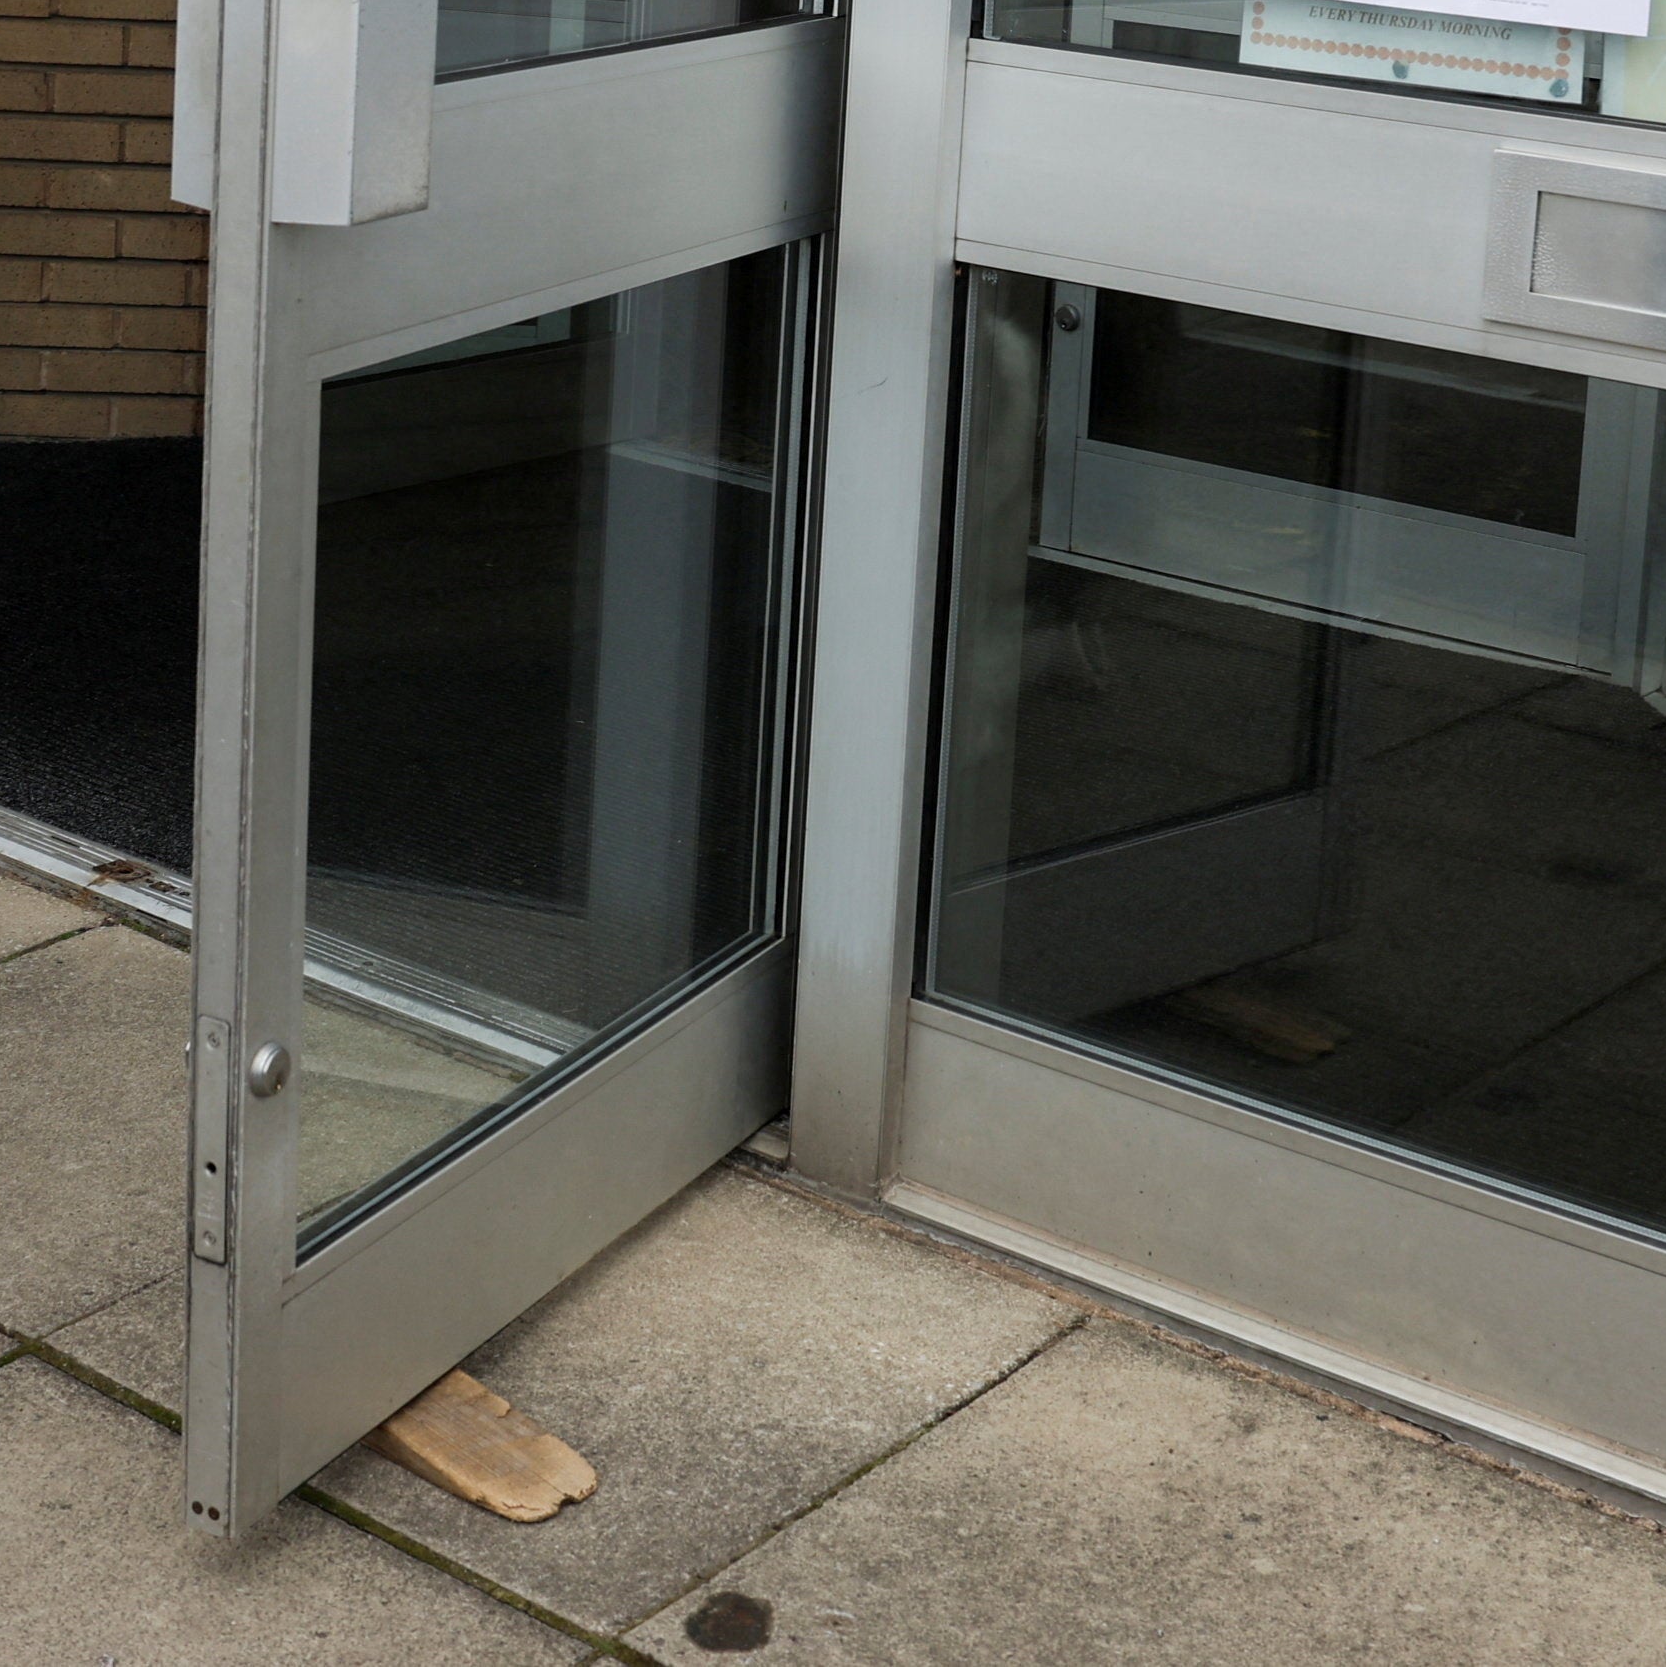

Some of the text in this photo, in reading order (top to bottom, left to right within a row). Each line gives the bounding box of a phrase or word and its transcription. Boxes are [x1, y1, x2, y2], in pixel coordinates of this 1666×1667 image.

[1309, 5, 1512, 41] EVERY THURSDAY MORNING
